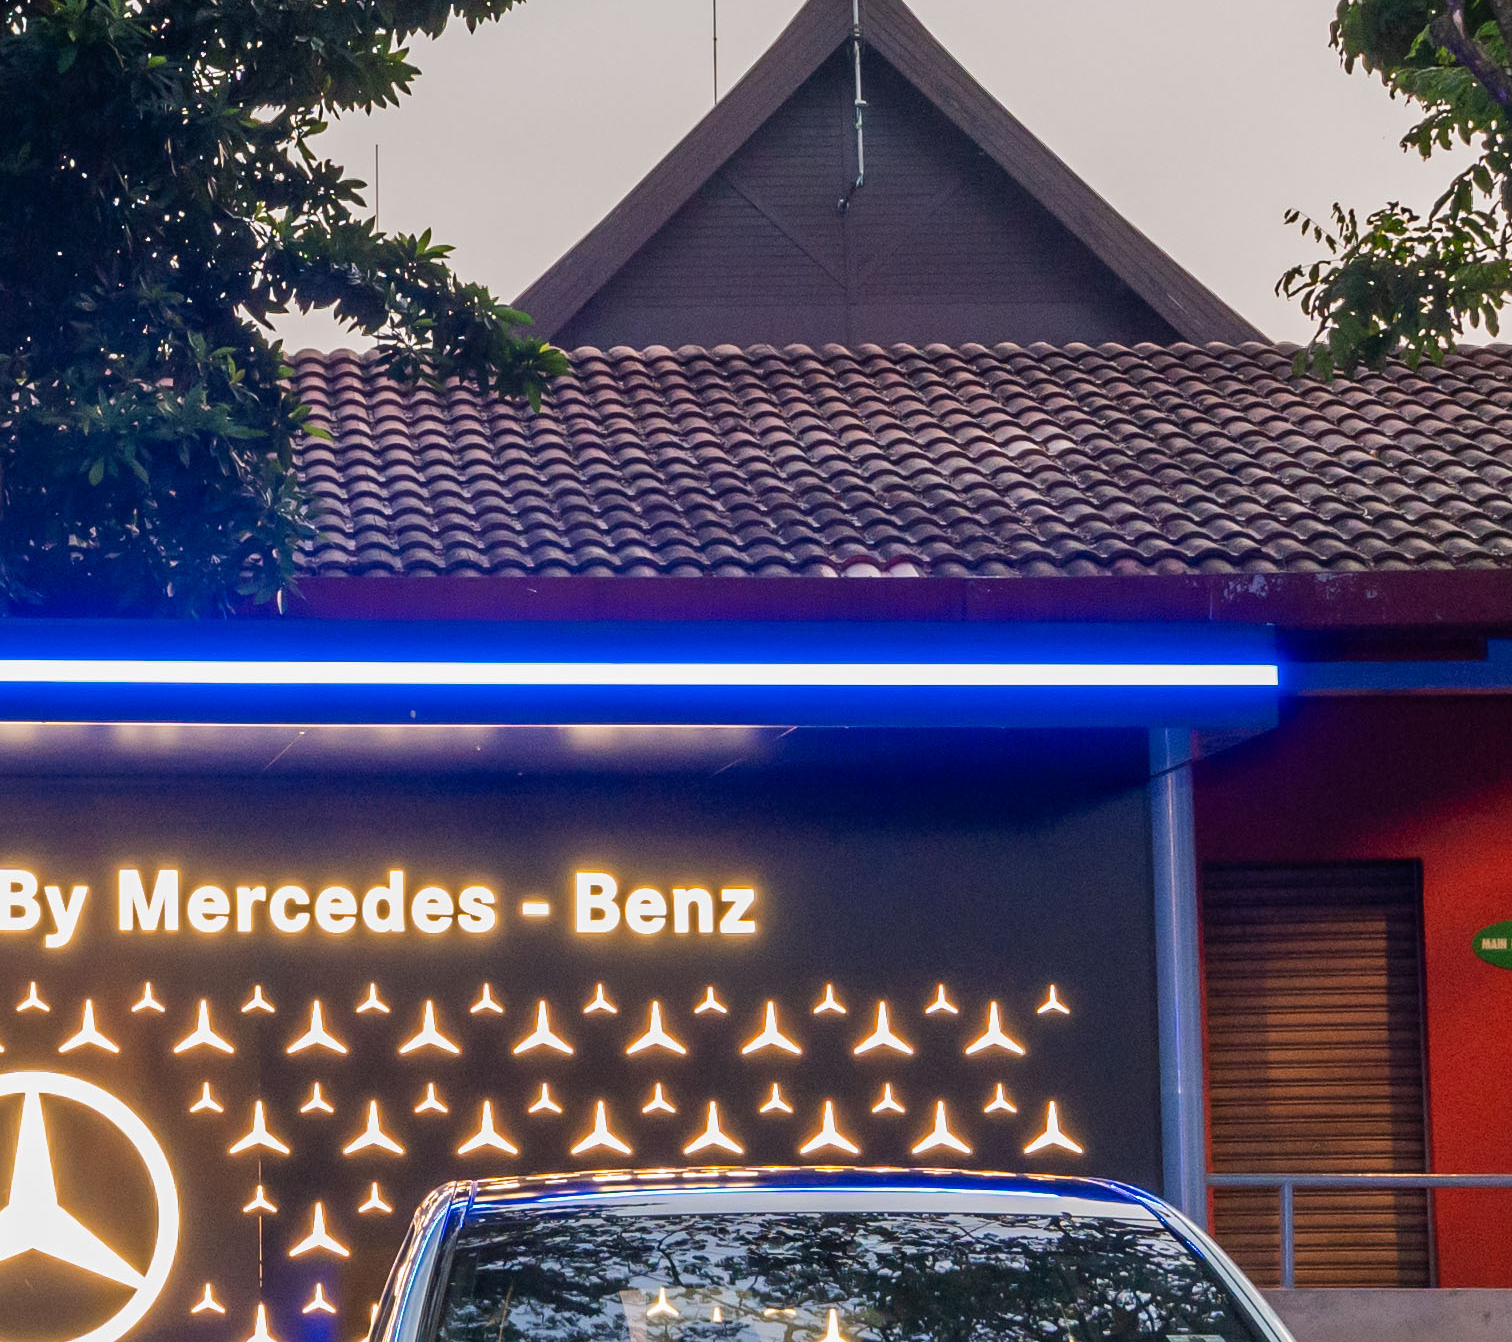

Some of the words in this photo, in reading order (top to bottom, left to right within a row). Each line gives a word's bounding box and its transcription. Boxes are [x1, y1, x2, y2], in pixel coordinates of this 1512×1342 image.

[118, 868, 497, 935] Mercedes
[575, 871, 757, 935] Benz
[1481, 938, 1508, 950] MAIN
